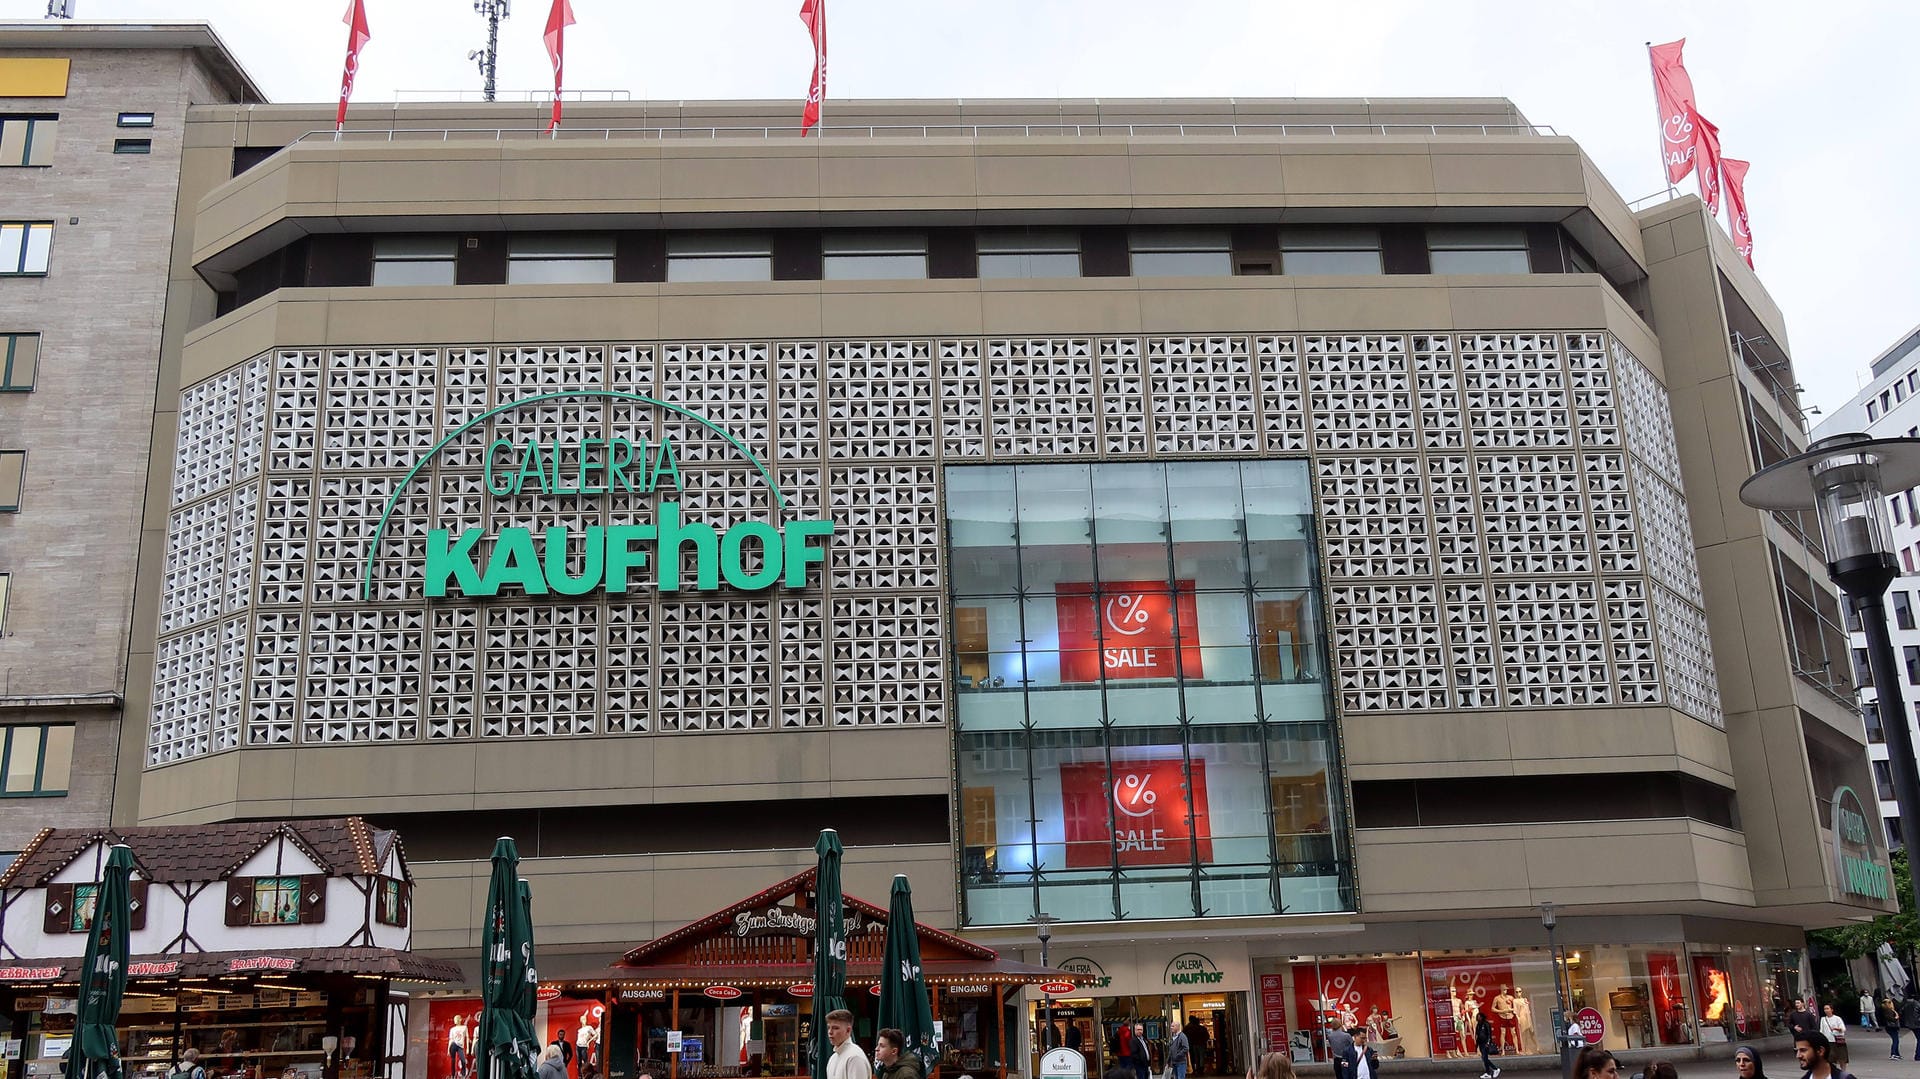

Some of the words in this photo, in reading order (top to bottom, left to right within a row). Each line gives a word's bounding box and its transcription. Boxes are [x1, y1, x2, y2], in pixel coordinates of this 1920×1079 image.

[485, 437, 683, 496] GALERIA
[1104, 646, 1157, 669] SALE
[1114, 829, 1165, 852] SALE
[735, 911, 767, 936] Zum
[767, 907, 817, 935] Lustige
[1176, 959, 1203, 970] GALERIA
[950, 984, 988, 993] EINGANG
[1047, 984, 1069, 992] Kaffee
[621, 989, 663, 999] AUSGANG
[1579, 1019, 1602, 1029] 50%
